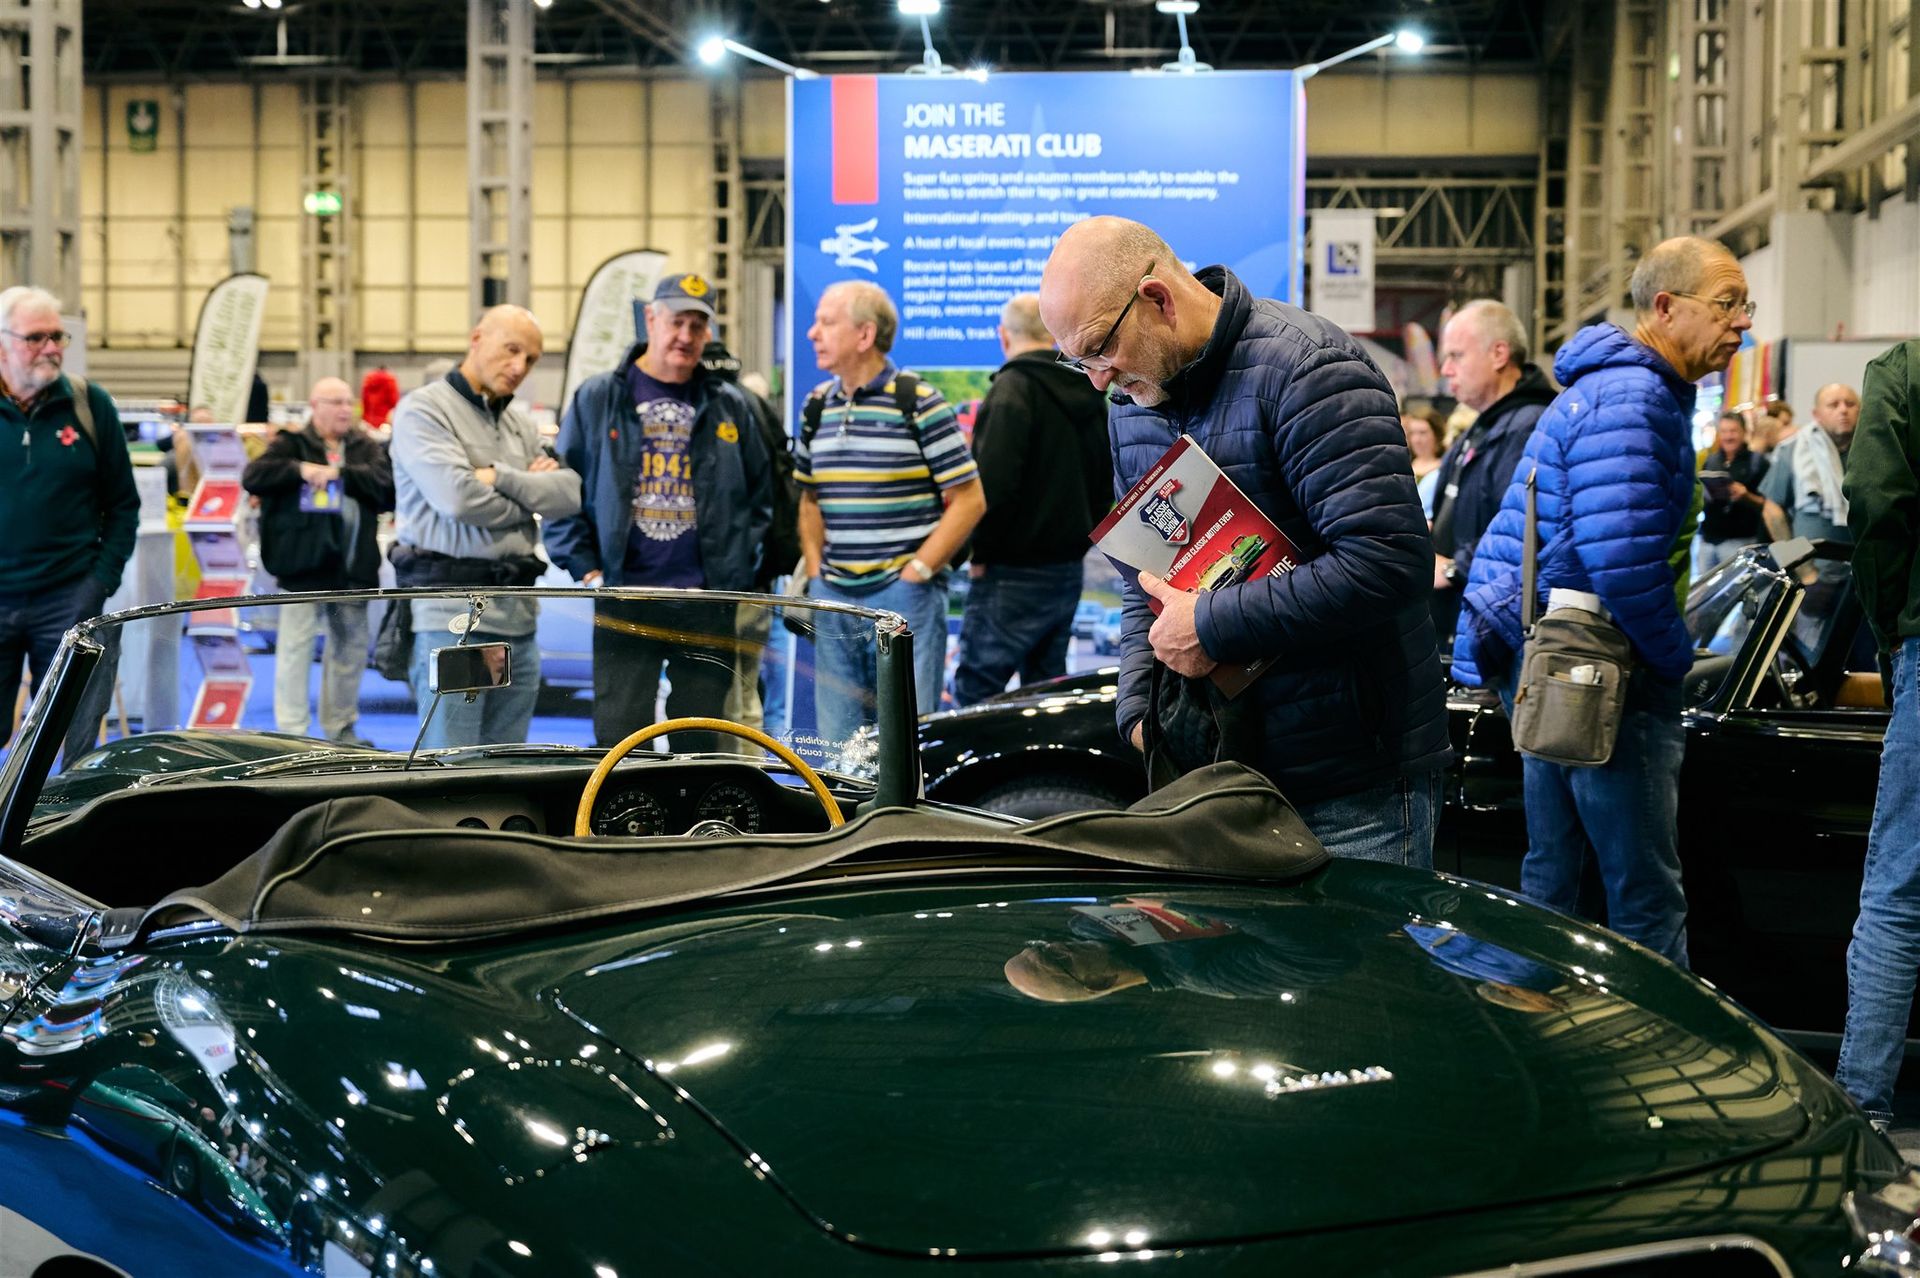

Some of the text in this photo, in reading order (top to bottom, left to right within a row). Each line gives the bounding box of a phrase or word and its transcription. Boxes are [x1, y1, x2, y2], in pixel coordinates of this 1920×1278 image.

[904, 102, 1005, 127] JOIN THE
[904, 133, 1102, 159] MASERATI CLUB
[903, 171, 938, 186] Super
[939, 171, 961, 184] fun
[962, 171, 999, 186] spring
[1000, 170, 1023, 184] and
[1024, 172, 1070, 184] autumn
[1072, 170, 1126, 184] members
[1160, 170, 1174, 184] to
[1175, 170, 1216, 184] enable
[1217, 170, 1239, 184] the
[903, 187, 949, 200] tridents
[950, 187, 965, 200] to
[966, 186, 1005, 199] stretch
[1007, 186, 1034, 199] their
[1036, 186, 1061, 201] legs
[1063, 187, 1075, 199] in
[1076, 186, 1108, 201] great
[1109, 186, 1162, 199] convivial
[903, 211, 979, 225] International
[981, 211, 1034, 226] meetings
[1035, 211, 1059, 225] and
[904, 237, 915, 249] A
[916, 236, 941, 249] host
[943, 236, 957, 249] of
[958, 235, 986, 249] local
[988, 237, 1025, 249] events
[1027, 235, 1050, 249] and
[903, 260, 947, 273] Receive
[949, 261, 973, 273] two
[975, 260, 1008, 273] issues
[1009, 259, 1023, 273] of
[903, 275, 946, 289] packed
[948, 275, 974, 288] with
[903, 290, 946, 304] regular
[903, 305, 943, 320] gossip,
[945, 305, 982, 318] events
[903, 326, 995, 341] Hill climbs, track
[1149, 500, 1170, 525] CLASSIC
[1156, 509, 1175, 531] MOTOR
[1163, 516, 1180, 536] SHOW
[1173, 551, 1193, 572] PREMIER
[1190, 536, 1208, 556] CLASSIC
[1205, 521, 1223, 541] MOTOR
[1218, 508, 1235, 527] EVENT
